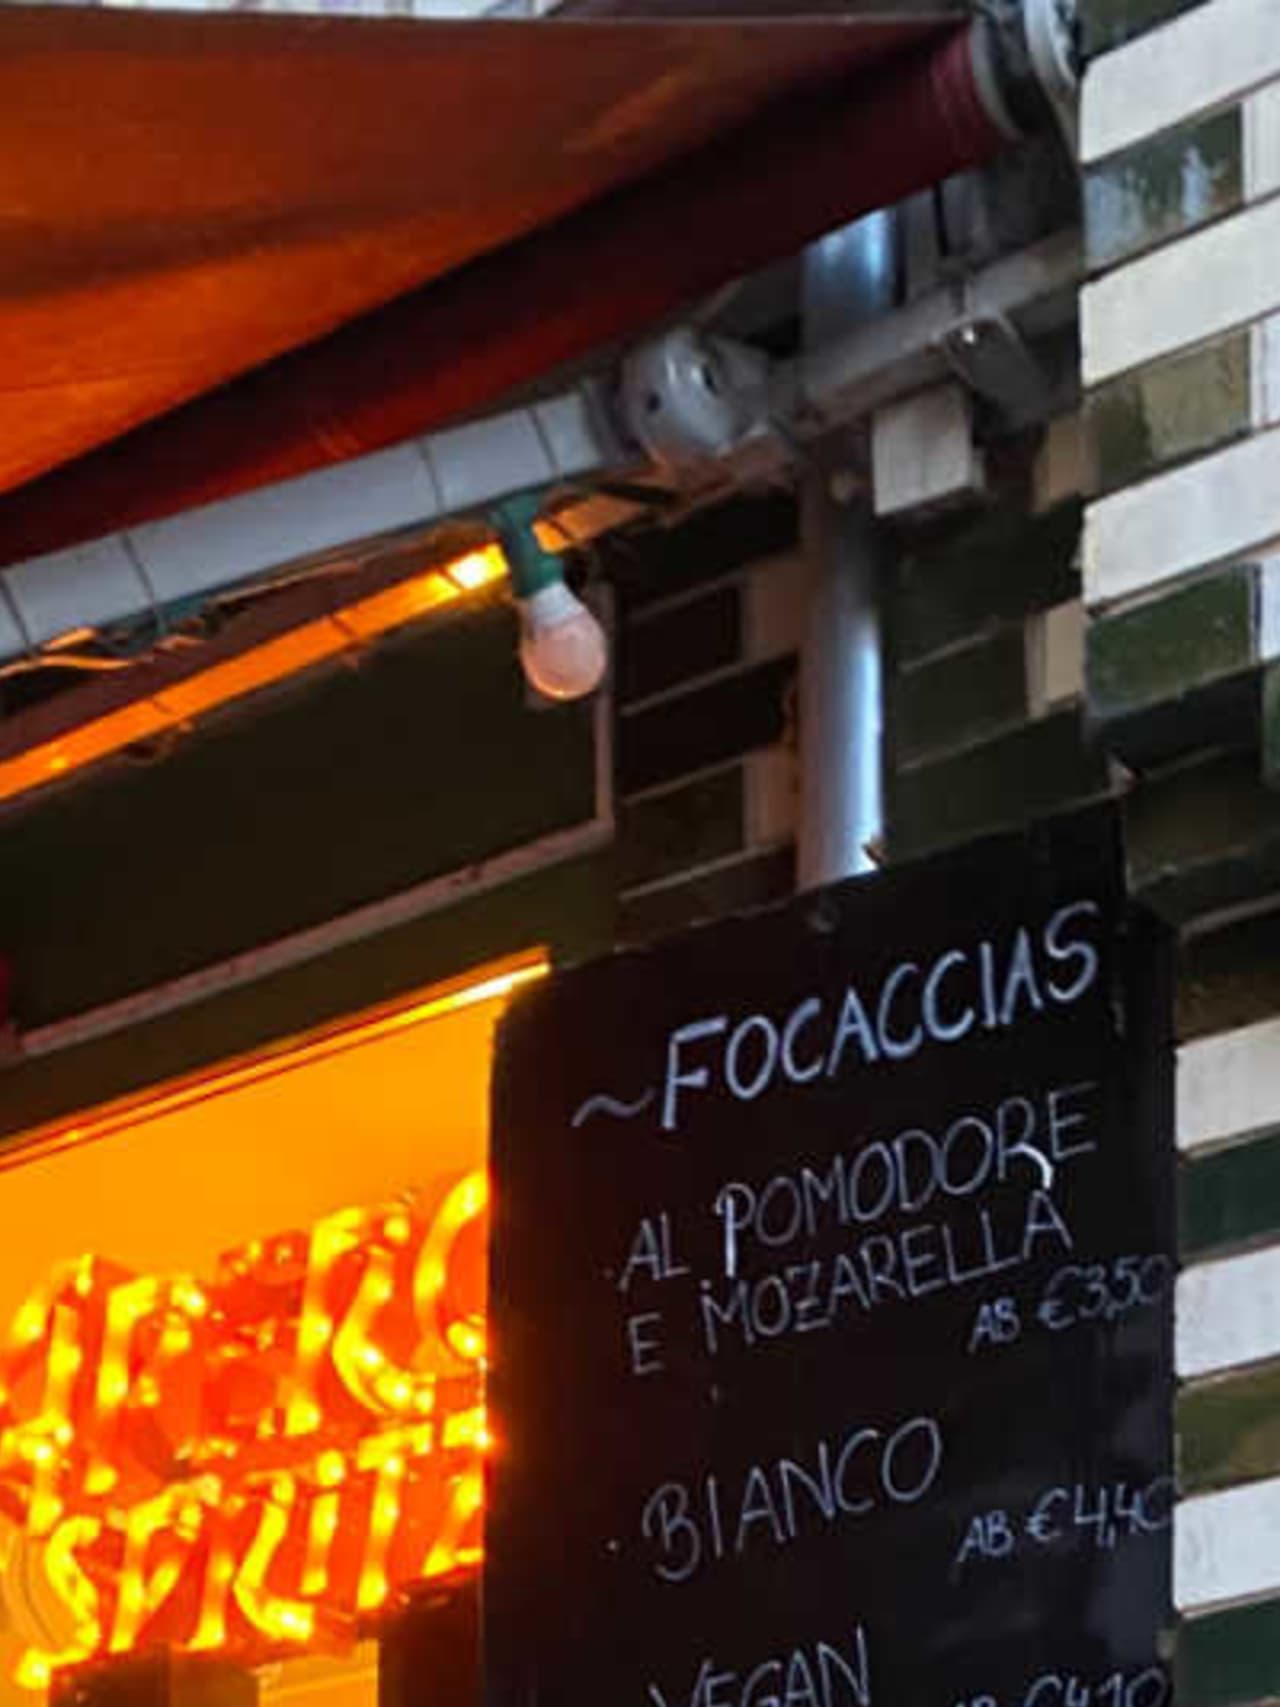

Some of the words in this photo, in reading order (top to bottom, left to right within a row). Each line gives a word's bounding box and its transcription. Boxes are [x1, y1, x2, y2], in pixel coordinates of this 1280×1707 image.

[662, 900, 1099, 1130] FOCACCIAS
[621, 1211, 690, 1290] AL
[716, 1081, 1098, 1278] POMODORE
[628, 1310, 664, 1375] E
[701, 1188, 1074, 1354] MOZARELLA
[968, 1297, 1021, 1355] AB
[641, 1417, 943, 1581] BIANCO
[957, 1508, 1016, 1563] AB
